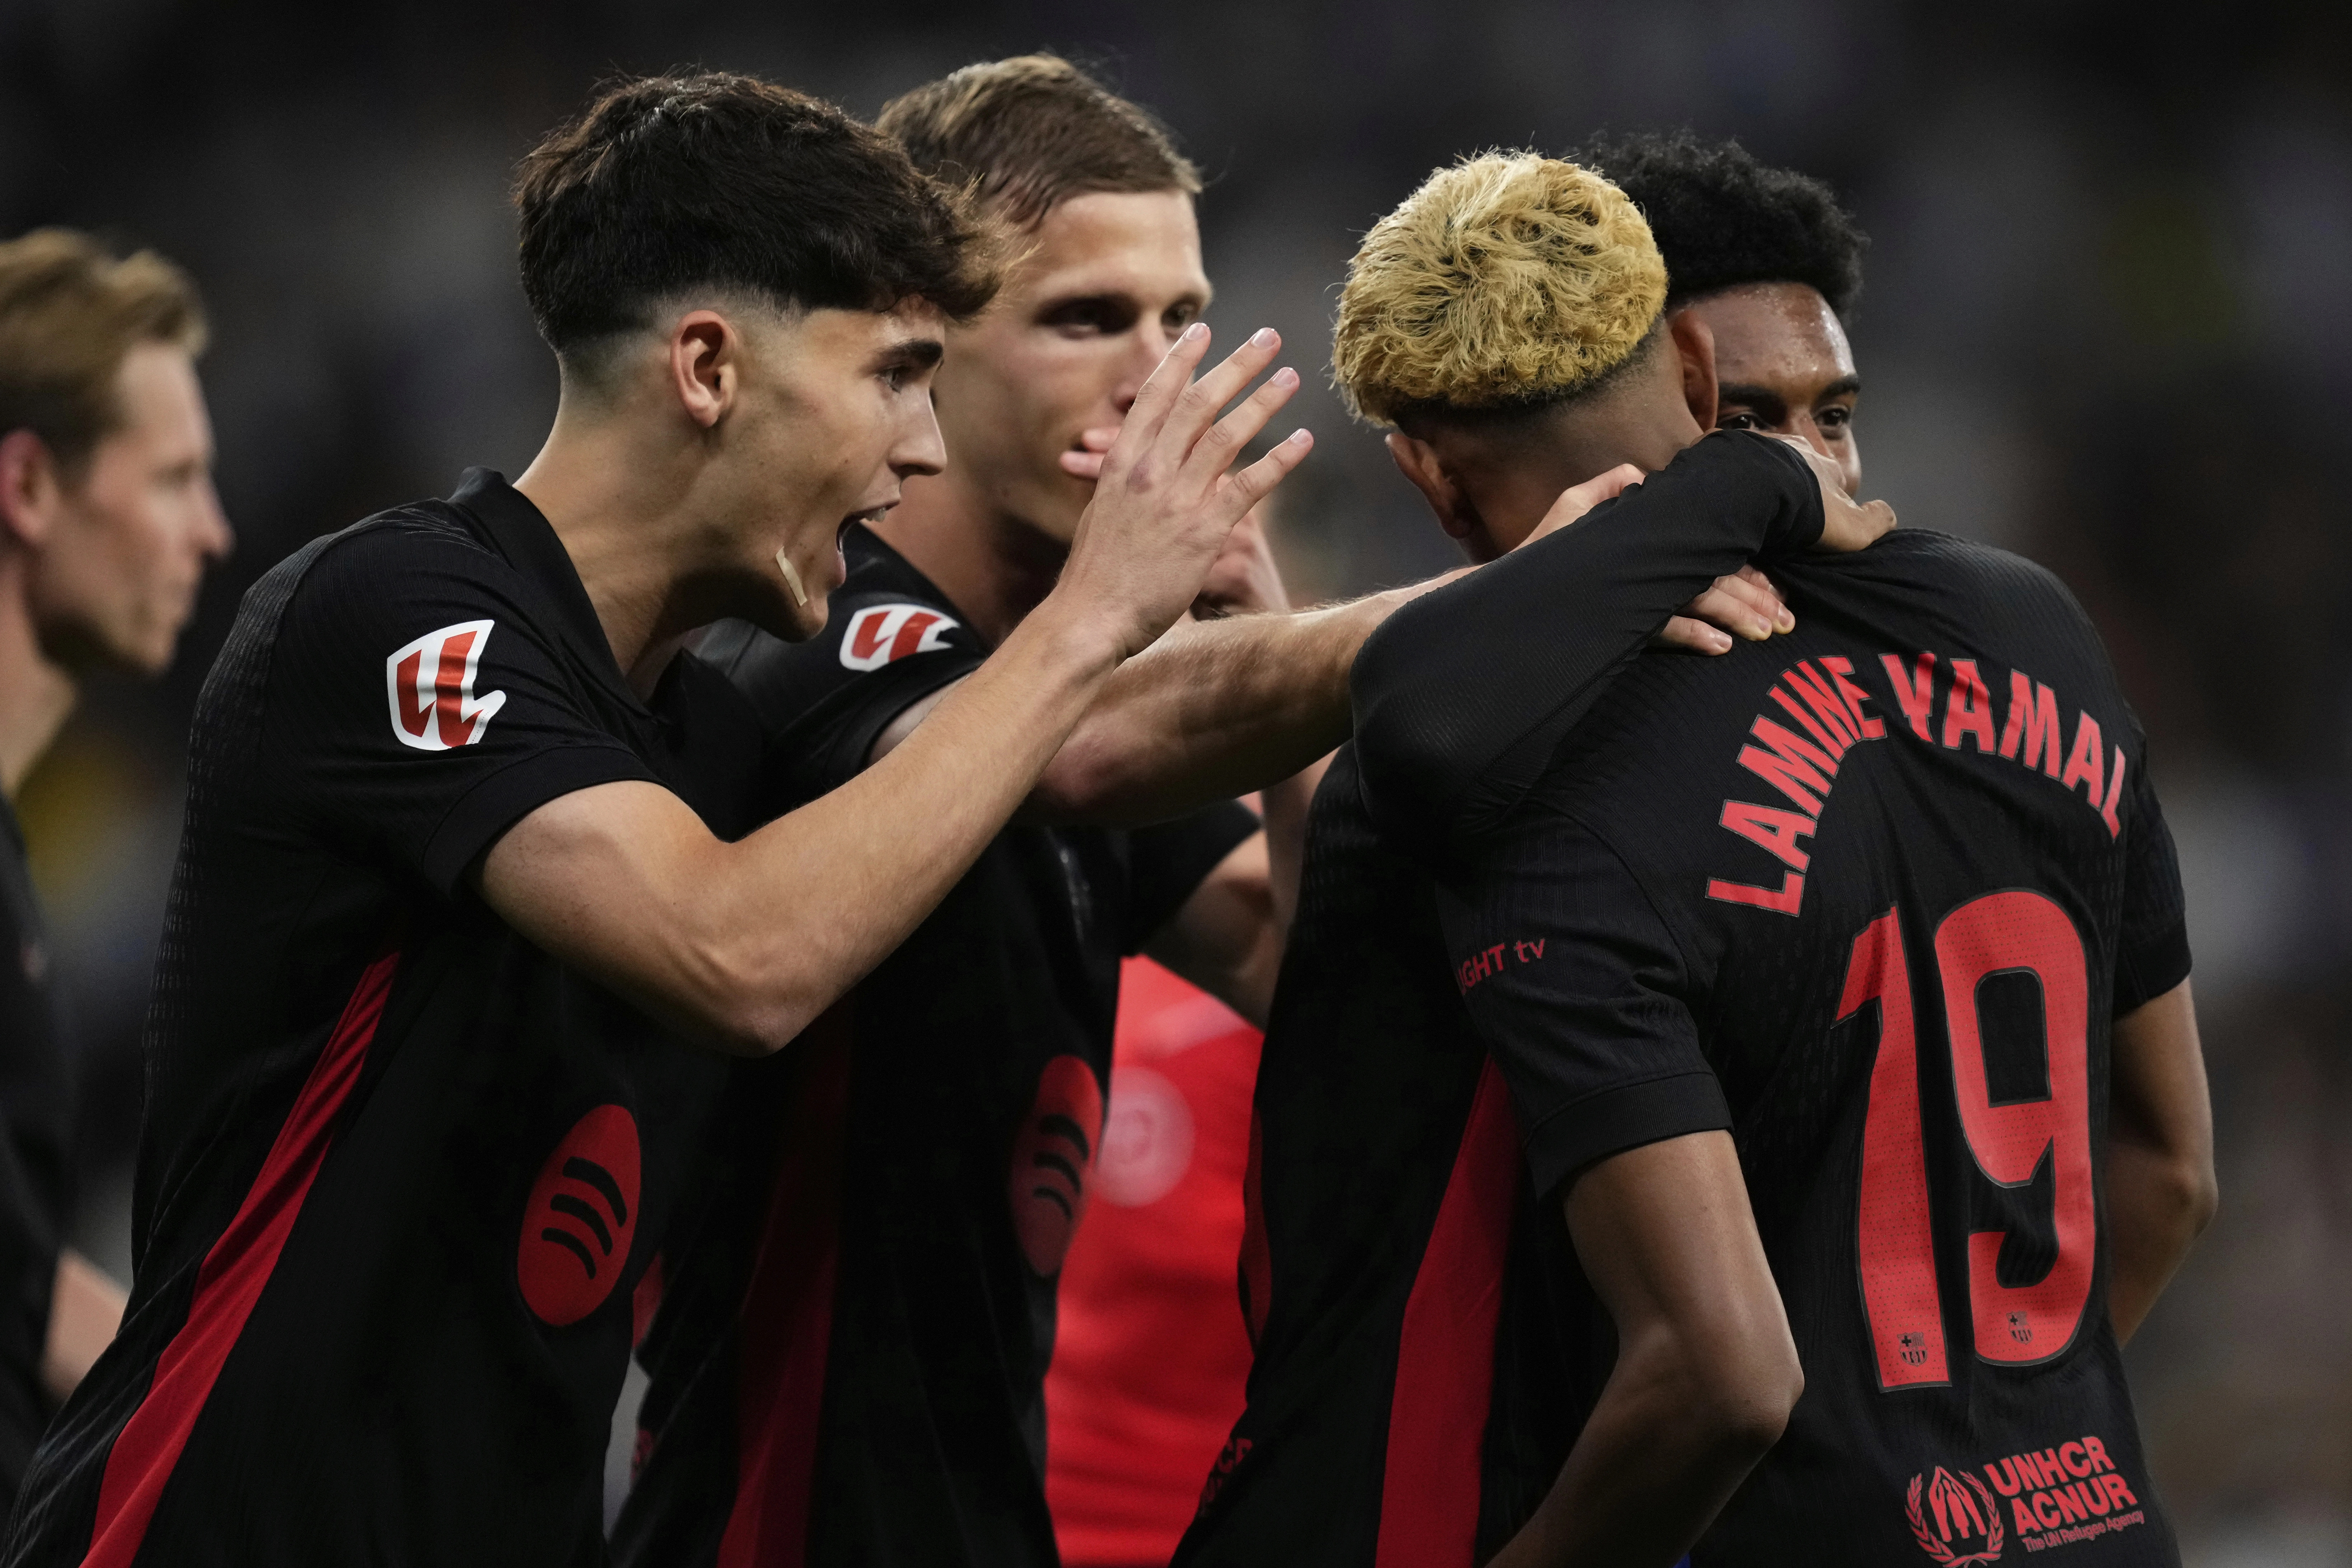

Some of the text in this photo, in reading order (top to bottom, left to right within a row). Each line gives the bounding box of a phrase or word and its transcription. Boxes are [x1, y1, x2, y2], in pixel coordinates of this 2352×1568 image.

[1705, 651, 2125, 917] LAMINE YAMAL
[1514, 938, 1545, 963] tv
[1830, 887, 2096, 1393] 19
[1983, 1436, 2116, 1497] UNHCR
[2011, 1473, 2138, 1535] ACNUR
[2022, 1511, 2145, 1552] The UN Refugee Agency
